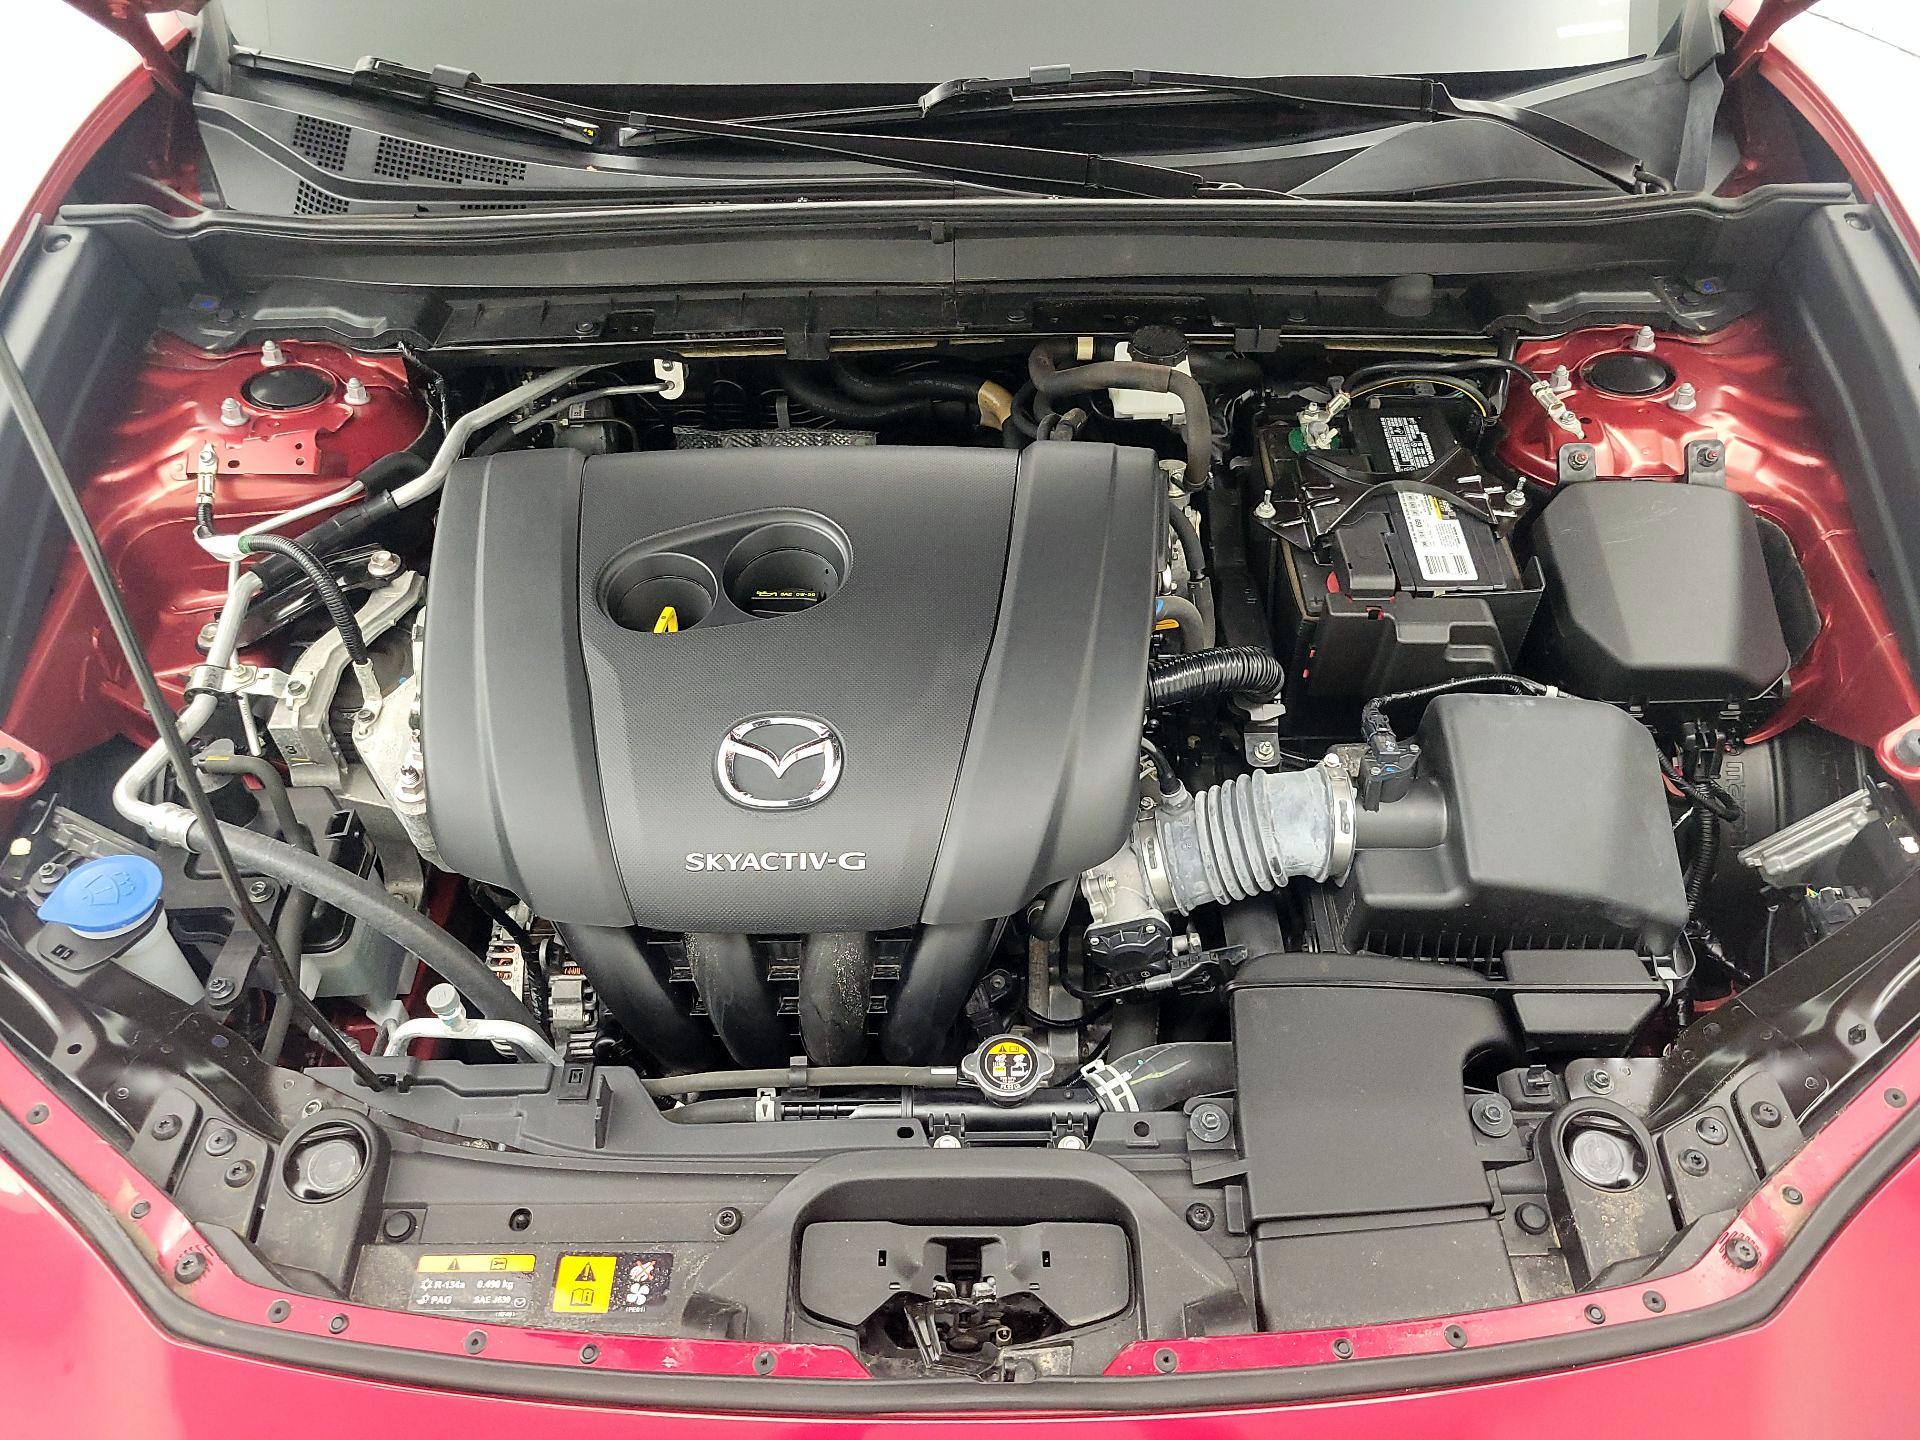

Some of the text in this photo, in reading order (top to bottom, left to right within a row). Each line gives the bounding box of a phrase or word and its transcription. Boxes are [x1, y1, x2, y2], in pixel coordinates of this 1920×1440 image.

[685, 851, 867, 872] SKYACTIV-G
[433, 1280, 466, 1290] R-134a
[501, 1279, 514, 1291] kg
[430, 1295, 453, 1305] PAG
[472, 1295, 492, 1305] SAE
